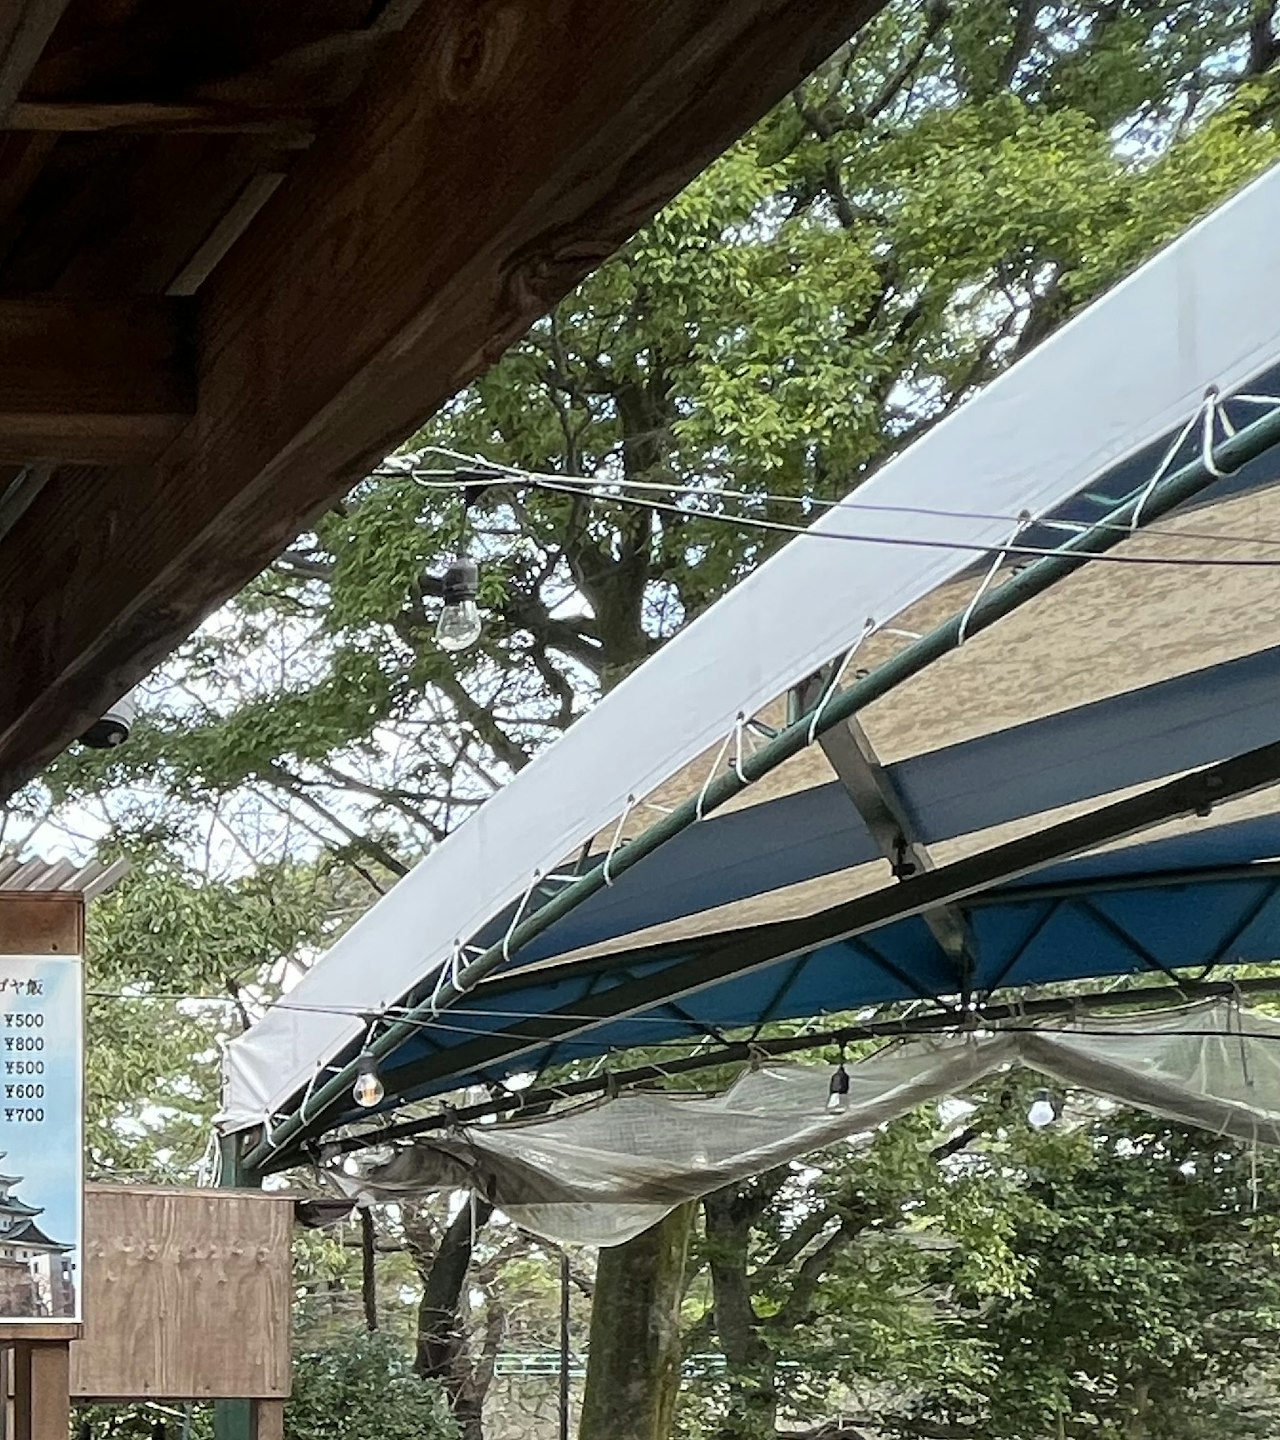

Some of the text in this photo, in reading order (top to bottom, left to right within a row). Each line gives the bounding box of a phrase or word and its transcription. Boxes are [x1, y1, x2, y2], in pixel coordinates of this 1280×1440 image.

[4, 1013, 44, 1028] ¥500
[4, 1036, 45, 1051] ¥800
[4, 1060, 45, 1075] ¥500
[4, 1084, 45, 1099] ¥600
[4, 1107, 45, 1122] ¥700
